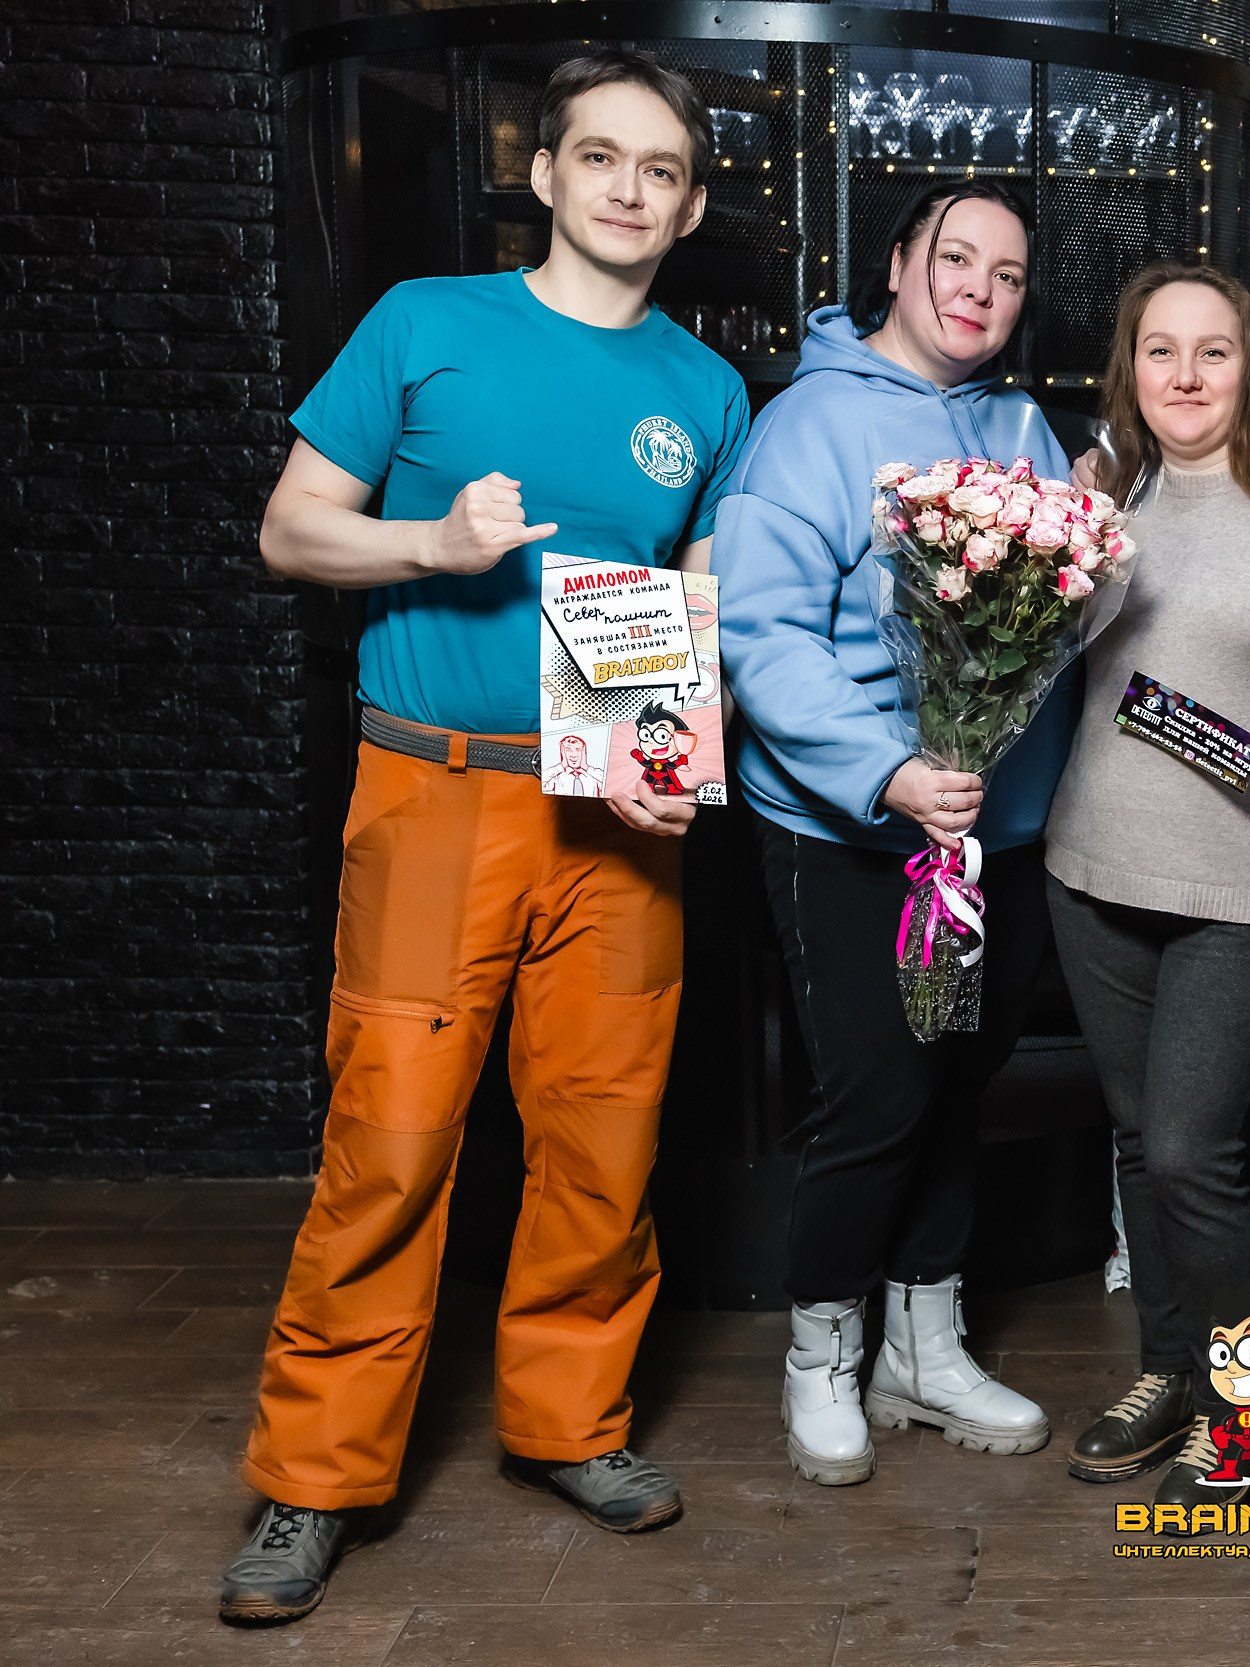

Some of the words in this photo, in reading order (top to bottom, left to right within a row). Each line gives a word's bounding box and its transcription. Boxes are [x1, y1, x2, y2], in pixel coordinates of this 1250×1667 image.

[671, 422, 691, 453] ISLAND
[645, 465, 683, 485] THAILAND
[563, 568, 651, 595] ДИПЛОМОМ
[553, 589, 623, 605] НАГРАЖДАЕТСЯ
[630, 583, 671, 595] КОМАНДА
[563, 606, 605, 622] Север
[604, 609, 672, 624] помнит
[574, 632, 627, 646] ЗАНЯВШАЯ
[653, 625, 683, 635] МЕСТО
[608, 639, 668, 653] СОСТЯЗАНИИ
[593, 651, 690, 685] BRAINBOY
[1164, 716, 1196, 737] Скидка
[1204, 739, 1221, 751] 20%
[1222, 749, 1233, 759] на
[1163, 725, 1181, 739] для
[1183, 736, 1210, 755] вашей
[1210, 752, 1248, 778] команды
[702, 794, 722, 803] 2026
